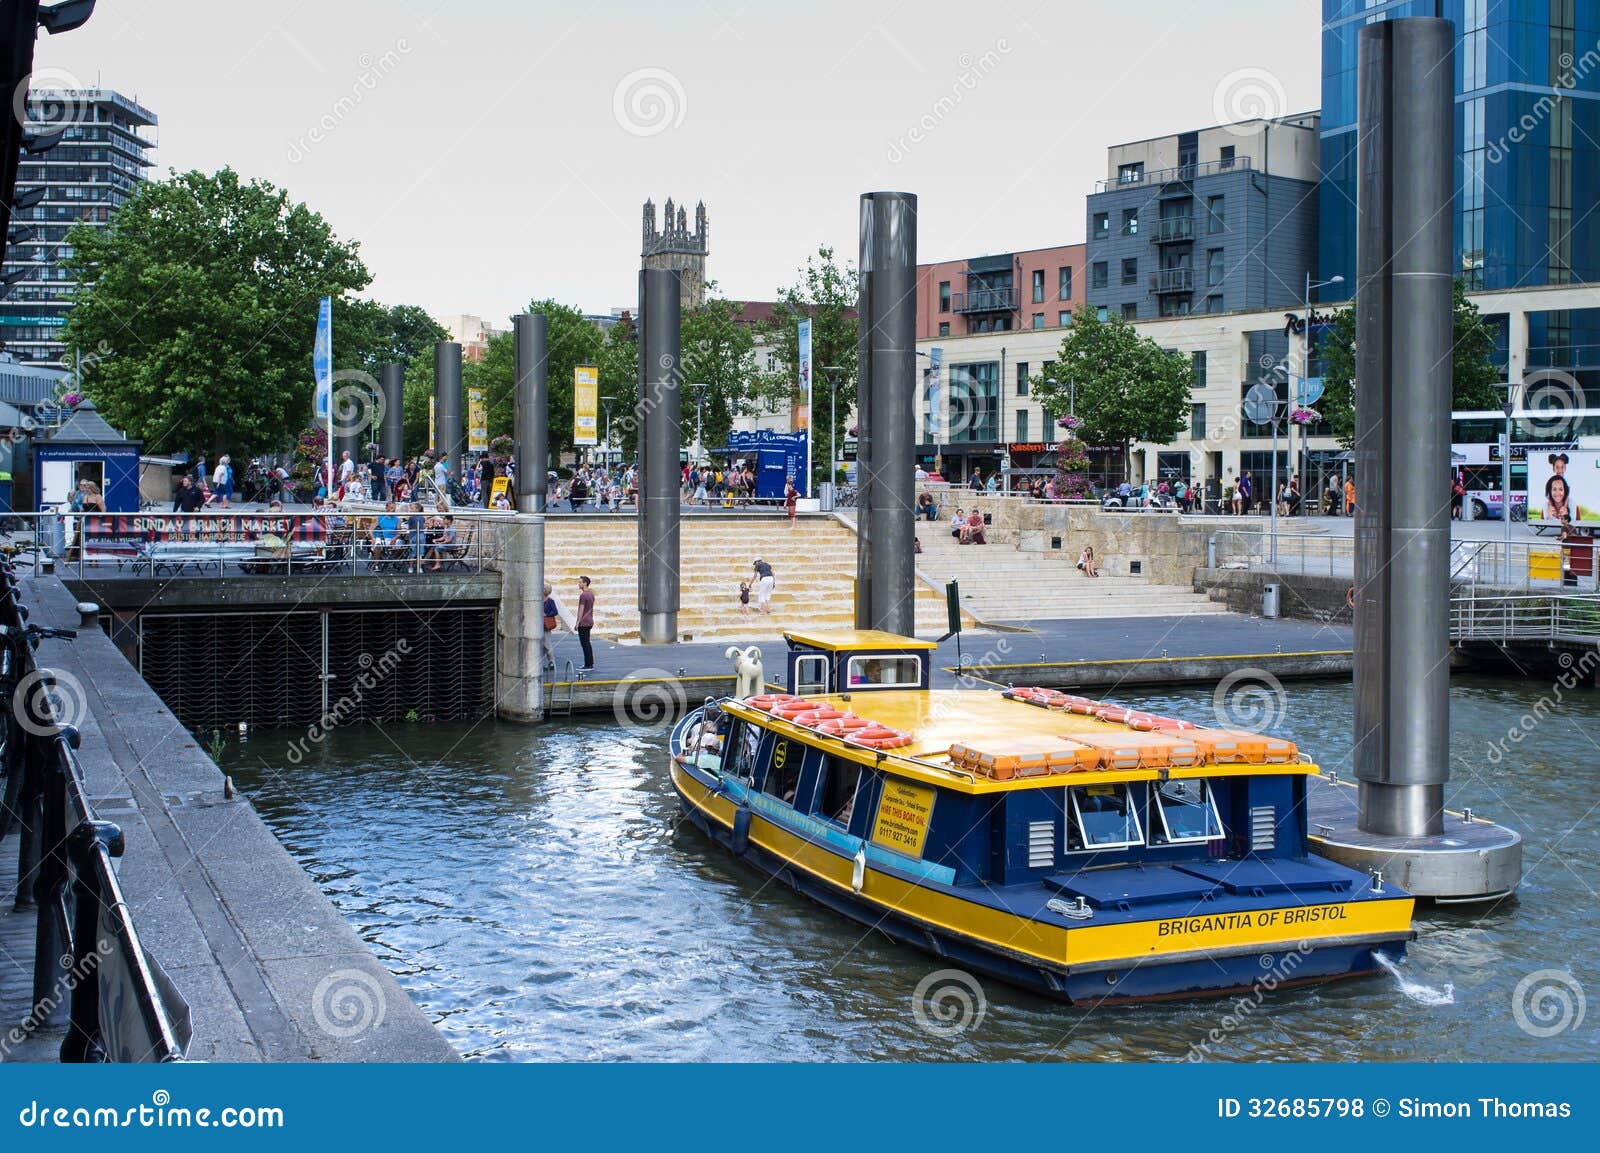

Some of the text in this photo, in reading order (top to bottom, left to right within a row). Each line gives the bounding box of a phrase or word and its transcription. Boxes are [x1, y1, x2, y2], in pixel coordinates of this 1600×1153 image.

[63, 89, 102, 97] TOWER
[1046, 443, 1059, 451] Loc
[1491, 448, 1524, 457] GOST
[133, 518, 293, 532] SUNDAY BRUNCH MARKET
[168, 532, 197, 541] BRISTOL
[902, 810, 916, 823] BOAT
[880, 827, 917, 847] 0117 927 3416
[1158, 905, 1347, 936] BRIGANTIA OF BRISTOL
